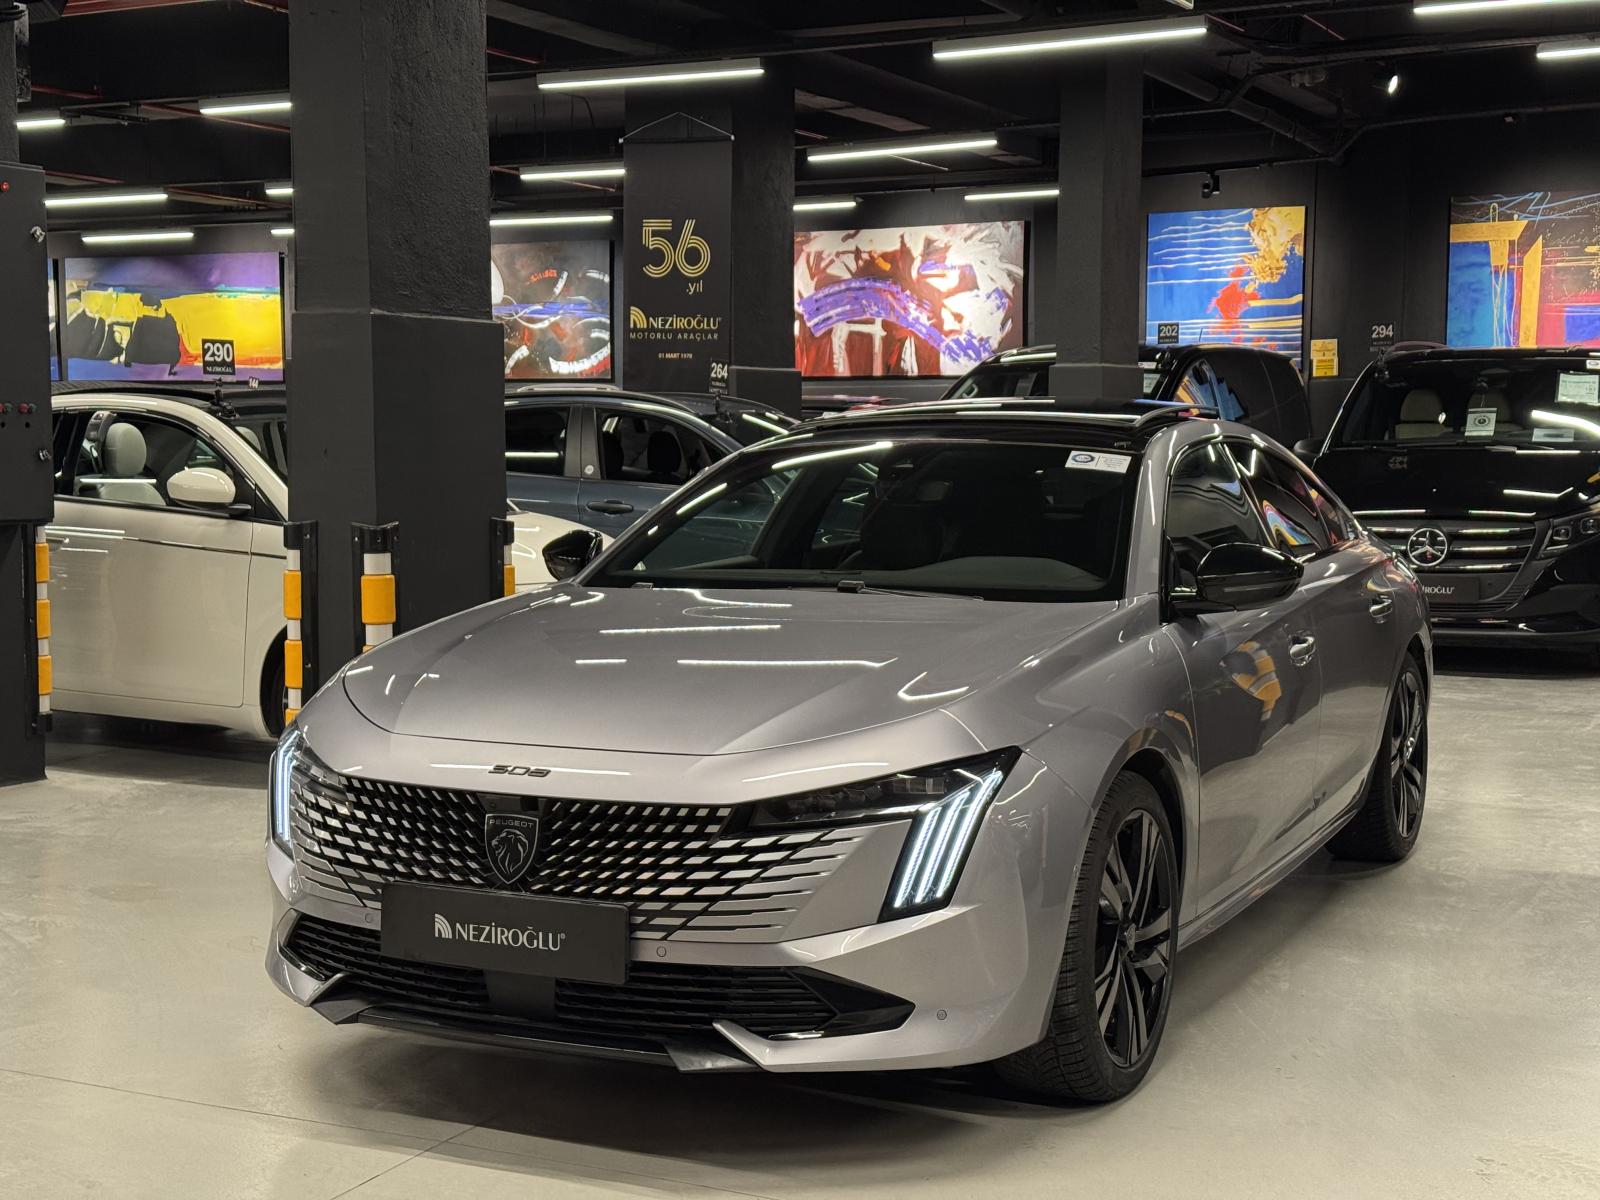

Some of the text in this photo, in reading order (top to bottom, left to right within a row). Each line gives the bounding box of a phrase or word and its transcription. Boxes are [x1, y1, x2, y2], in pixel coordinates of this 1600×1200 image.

[642, 218, 711, 278] 56
[629, 332, 719, 343] MOTORLU ARAÇLAR
[1159, 325, 1178, 337] 202
[1371, 324, 1394, 339] 294
[203, 342, 234, 362] 290
[710, 361, 729, 380] 264
[487, 764, 552, 778] 508
[489, 818, 534, 829] PEUGEOT
[455, 921, 561, 951] NEZİROĞLU
